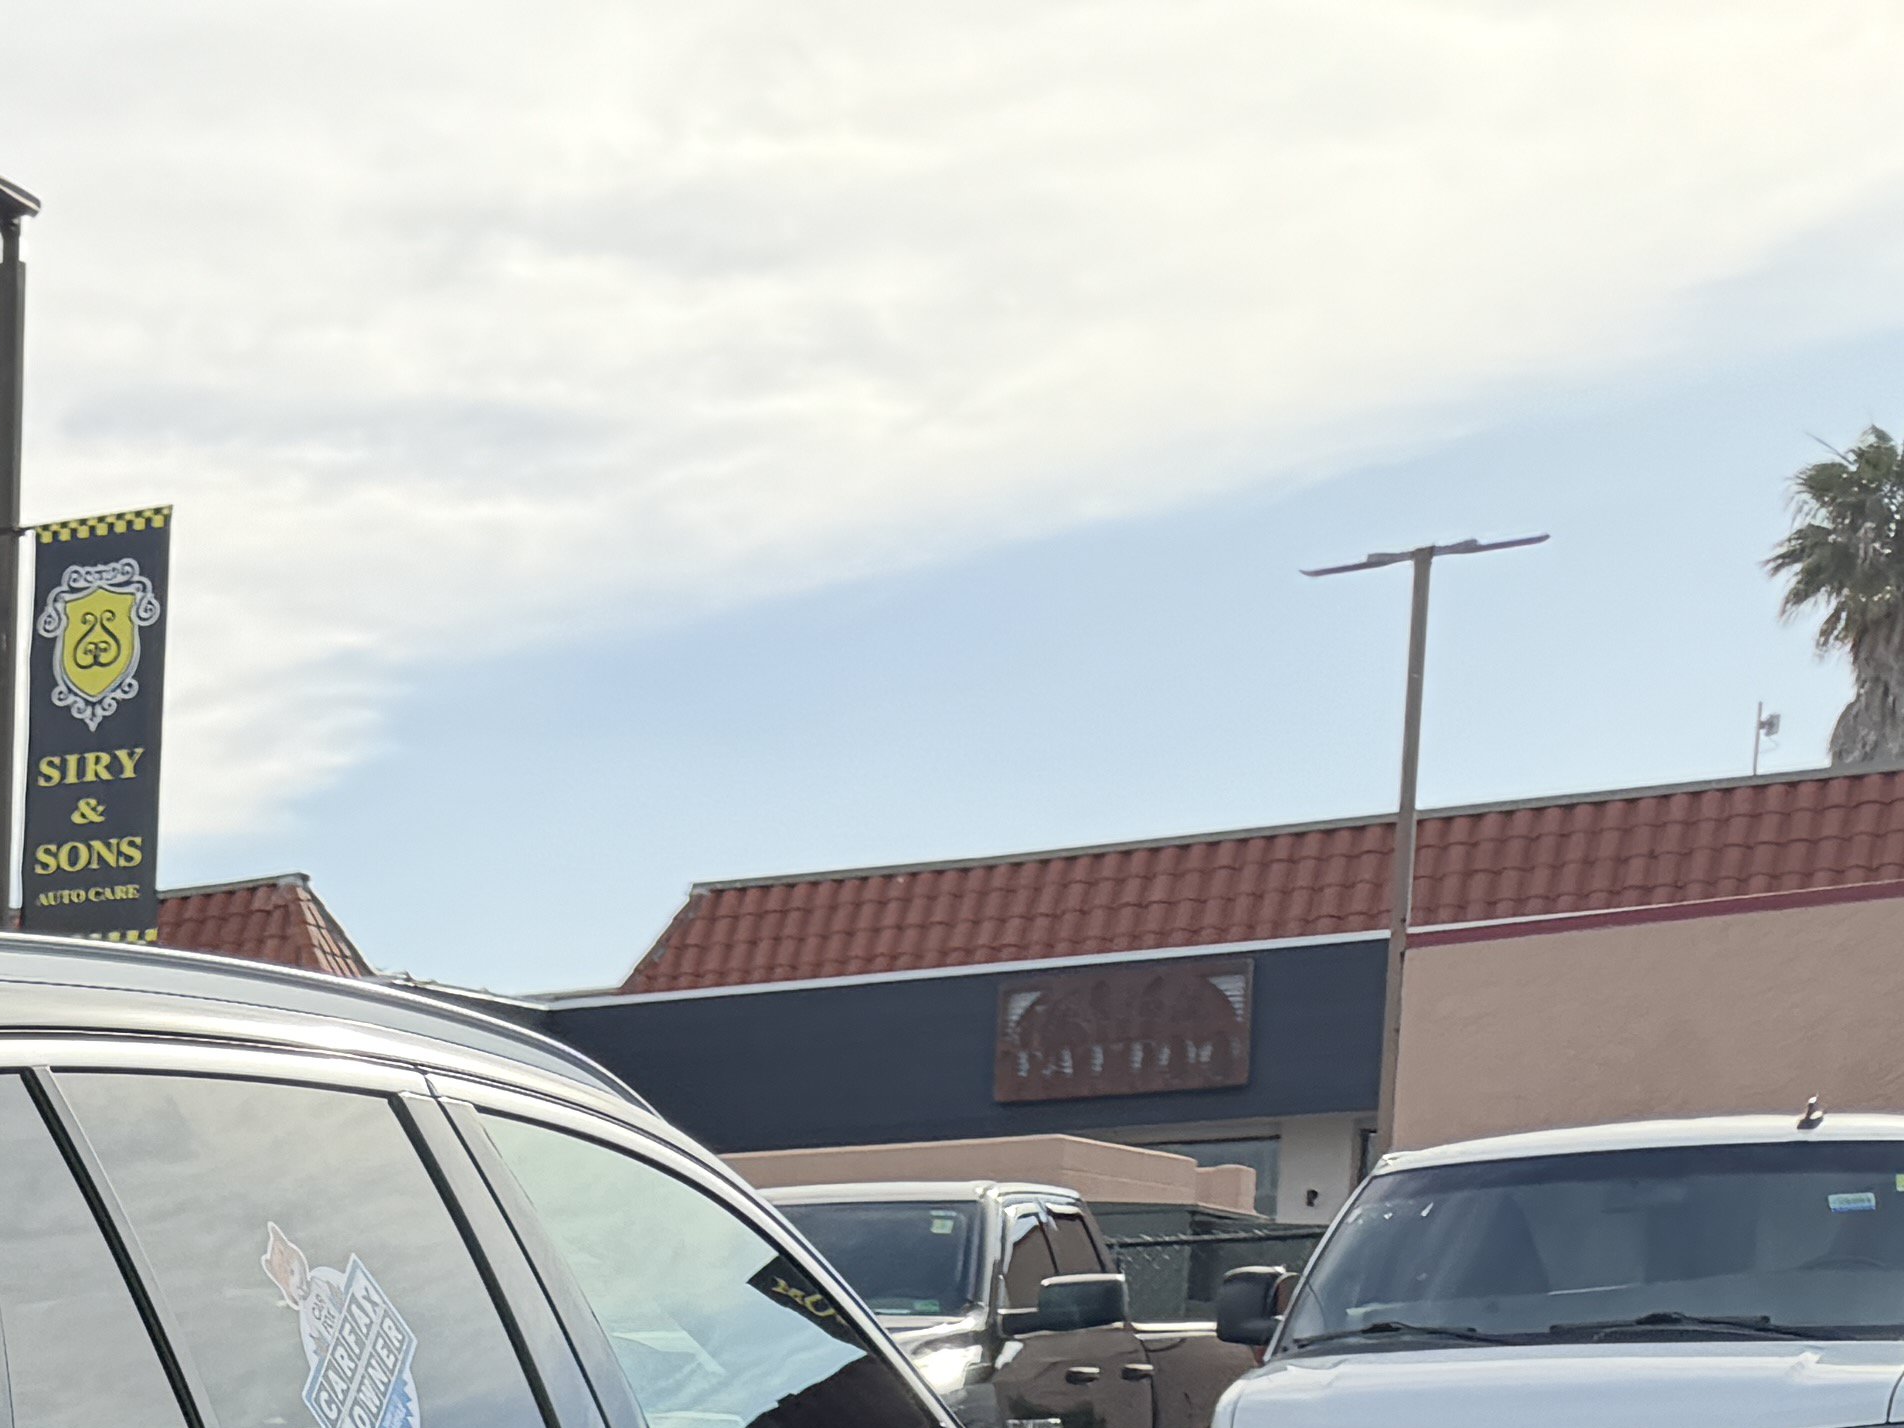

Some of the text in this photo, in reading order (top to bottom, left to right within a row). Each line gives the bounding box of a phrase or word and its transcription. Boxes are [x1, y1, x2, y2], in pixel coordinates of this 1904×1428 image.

[37, 746, 144, 787] SIRY
[70, 798, 107, 824] &
[34, 836, 143, 875] SONS
[38, 884, 140, 907] AUTO CARE
[319, 1286, 381, 1421] CARFAX
